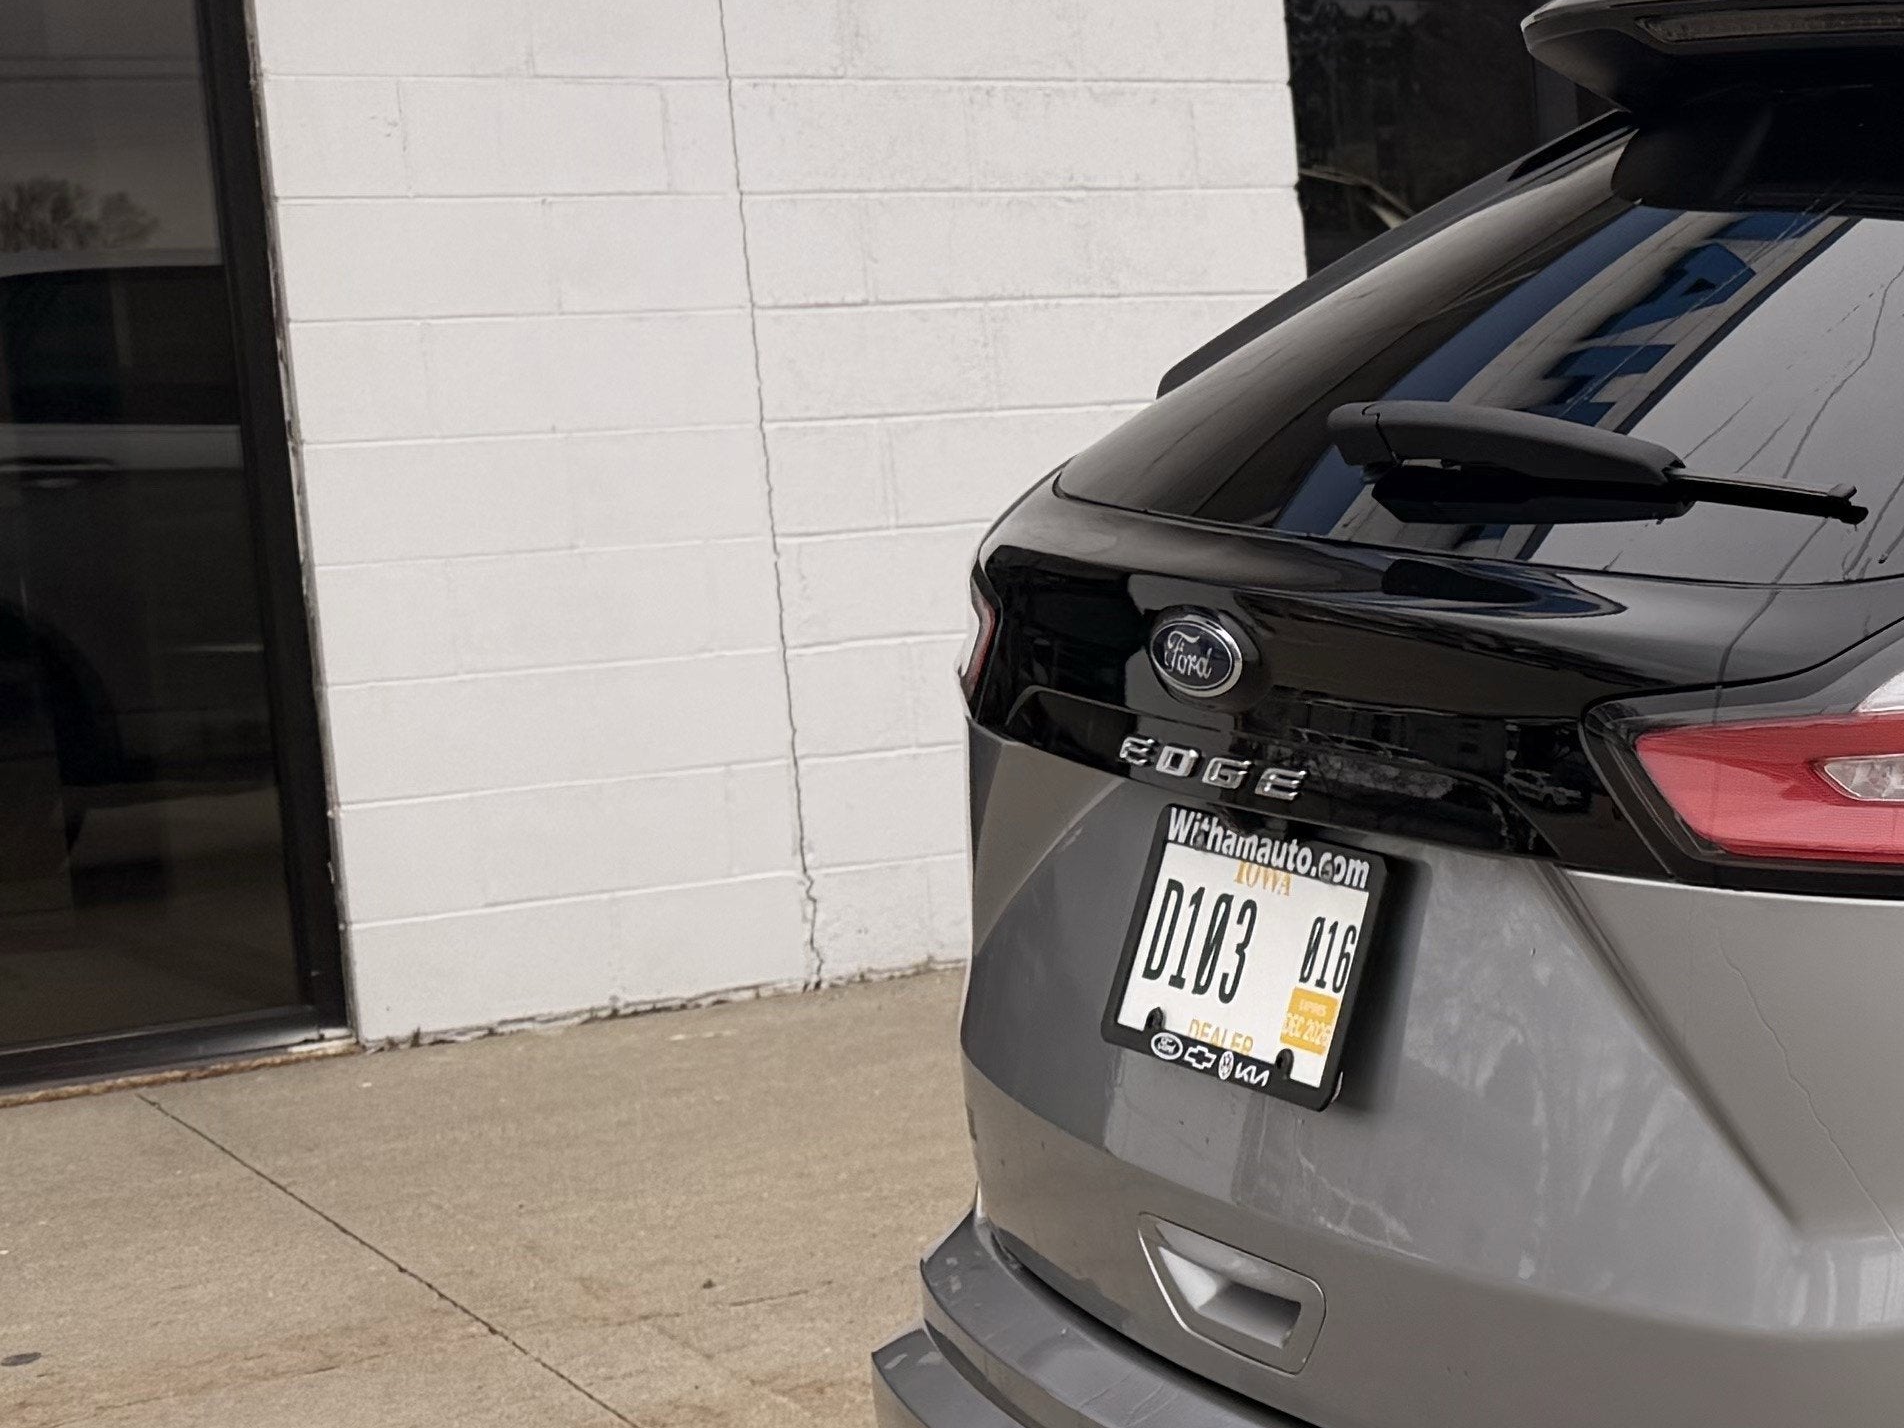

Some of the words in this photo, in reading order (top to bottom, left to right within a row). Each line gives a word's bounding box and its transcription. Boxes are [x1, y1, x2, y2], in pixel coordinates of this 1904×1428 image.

[1164, 629, 1212, 680] Ford
[1119, 736, 1307, 800] EDGE
[1168, 807, 1370, 889] Withamauto.com
[1233, 860, 1294, 897] IOWA
[1141, 878, 1258, 1004] D103
[1299, 916, 1357, 993] 016
